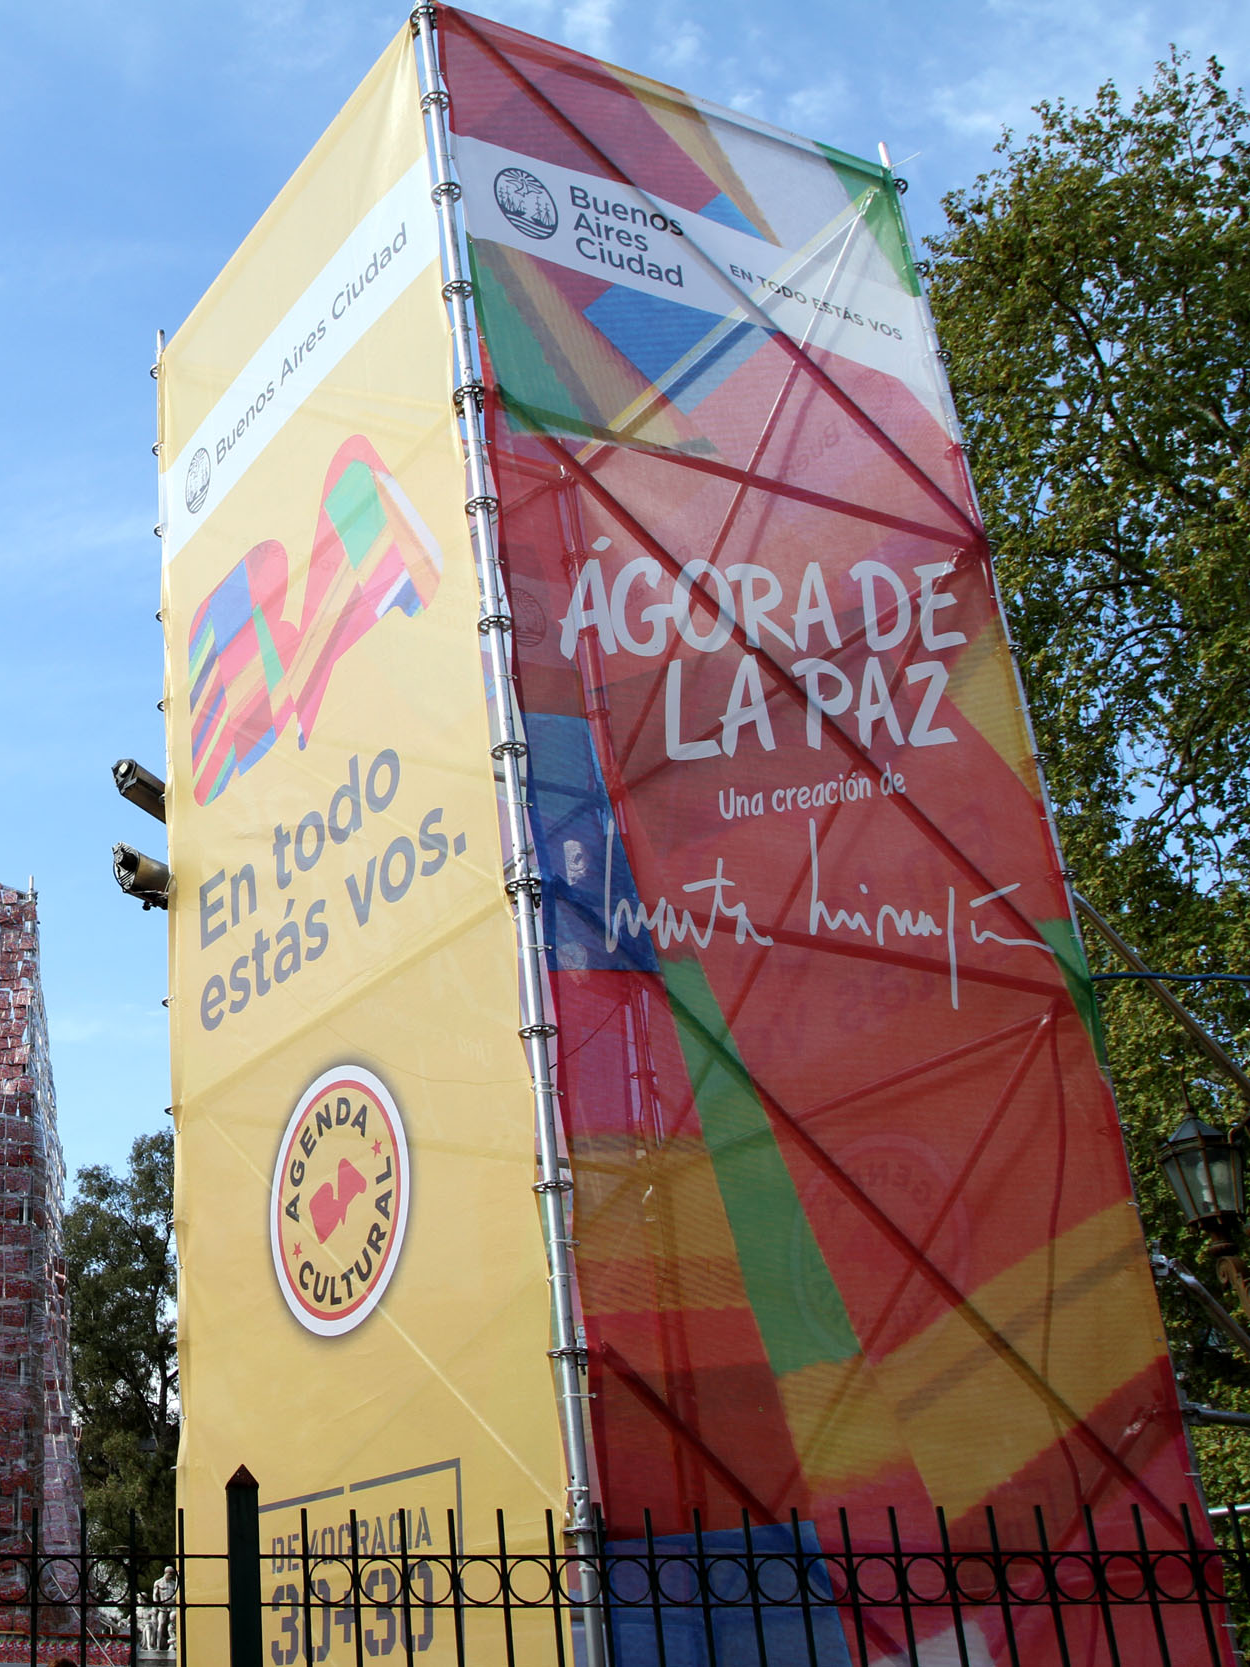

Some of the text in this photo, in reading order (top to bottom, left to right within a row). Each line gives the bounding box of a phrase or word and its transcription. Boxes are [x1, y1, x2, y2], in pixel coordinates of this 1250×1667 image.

[568, 184, 685, 238] Buenos
[572, 211, 649, 252] Aires
[575, 236, 684, 288] Ciudad
[216, 222, 408, 466] Buenos Aires Ciudad
[729, 262, 903, 342] EN TODO ESTÁS VOS
[558, 536, 968, 661] ÁGORA DE
[664, 654, 958, 761] LA PAZ
[199, 748, 401, 951] En todo
[718, 762, 907, 821] Una creación de
[200, 807, 468, 1032] estás vos.
[285, 1097, 368, 1222] AGENDA
[299, 1155, 393, 1306] CULTURAL
